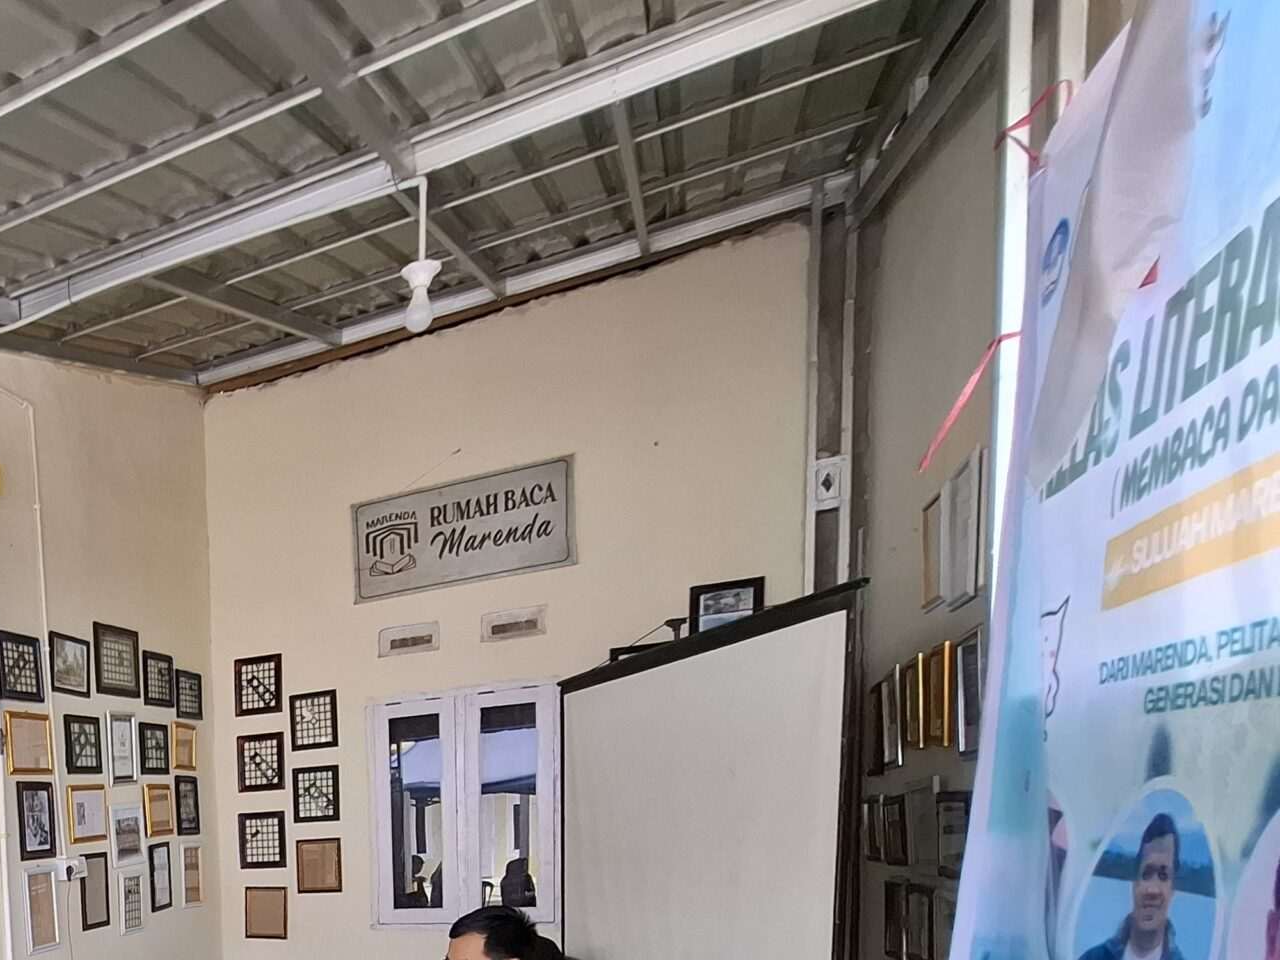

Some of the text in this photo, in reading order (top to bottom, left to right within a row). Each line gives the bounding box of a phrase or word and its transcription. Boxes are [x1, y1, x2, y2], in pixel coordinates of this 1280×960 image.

[366, 511, 417, 530] MARENDA
[429, 482, 558, 528] RUMAH BACA
[429, 512, 556, 561] Marenda
[1099, 654, 1130, 685] DARI
[1143, 673, 1226, 715] GENERASI
